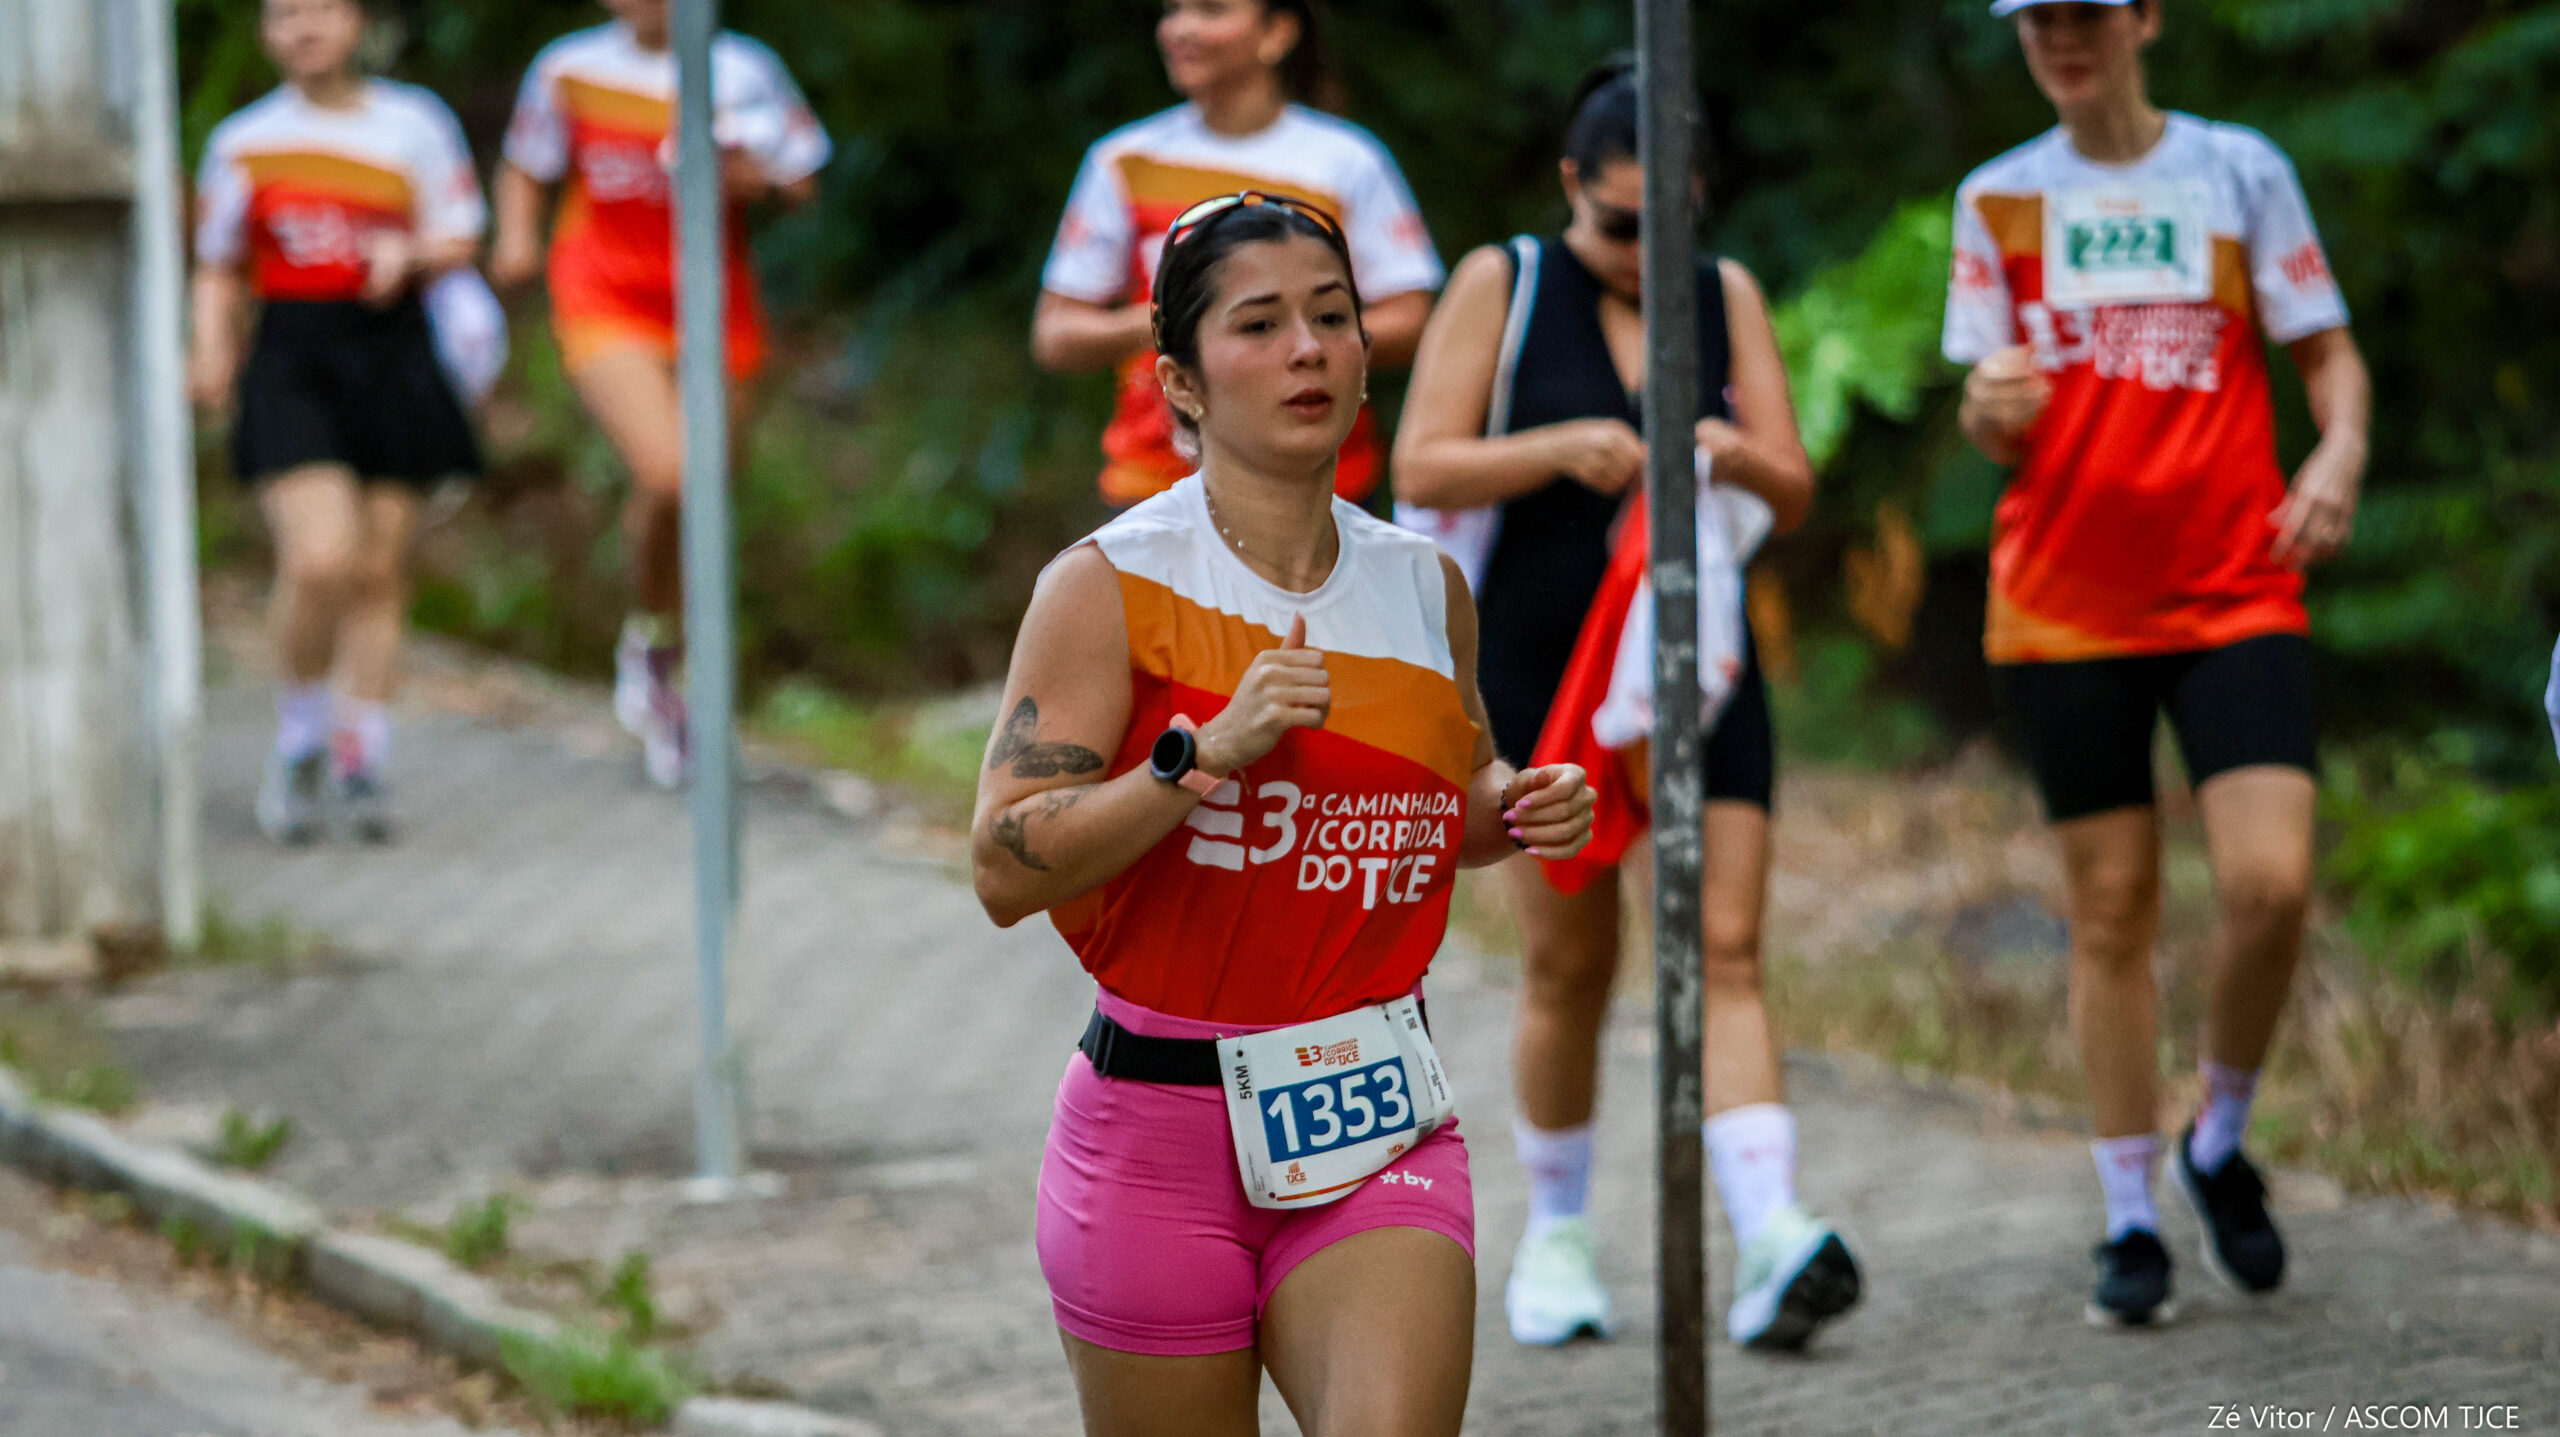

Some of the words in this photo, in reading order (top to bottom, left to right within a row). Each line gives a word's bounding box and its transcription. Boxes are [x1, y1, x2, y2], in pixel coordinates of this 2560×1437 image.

[1321, 792, 1459, 816] CAMINHADA
[1297, 855, 1352, 891] DO
[1234, 1064, 1253, 1100] 5KM
[1267, 1064, 1410, 1153] 1353
[1403, 1170, 1433, 1191] by
